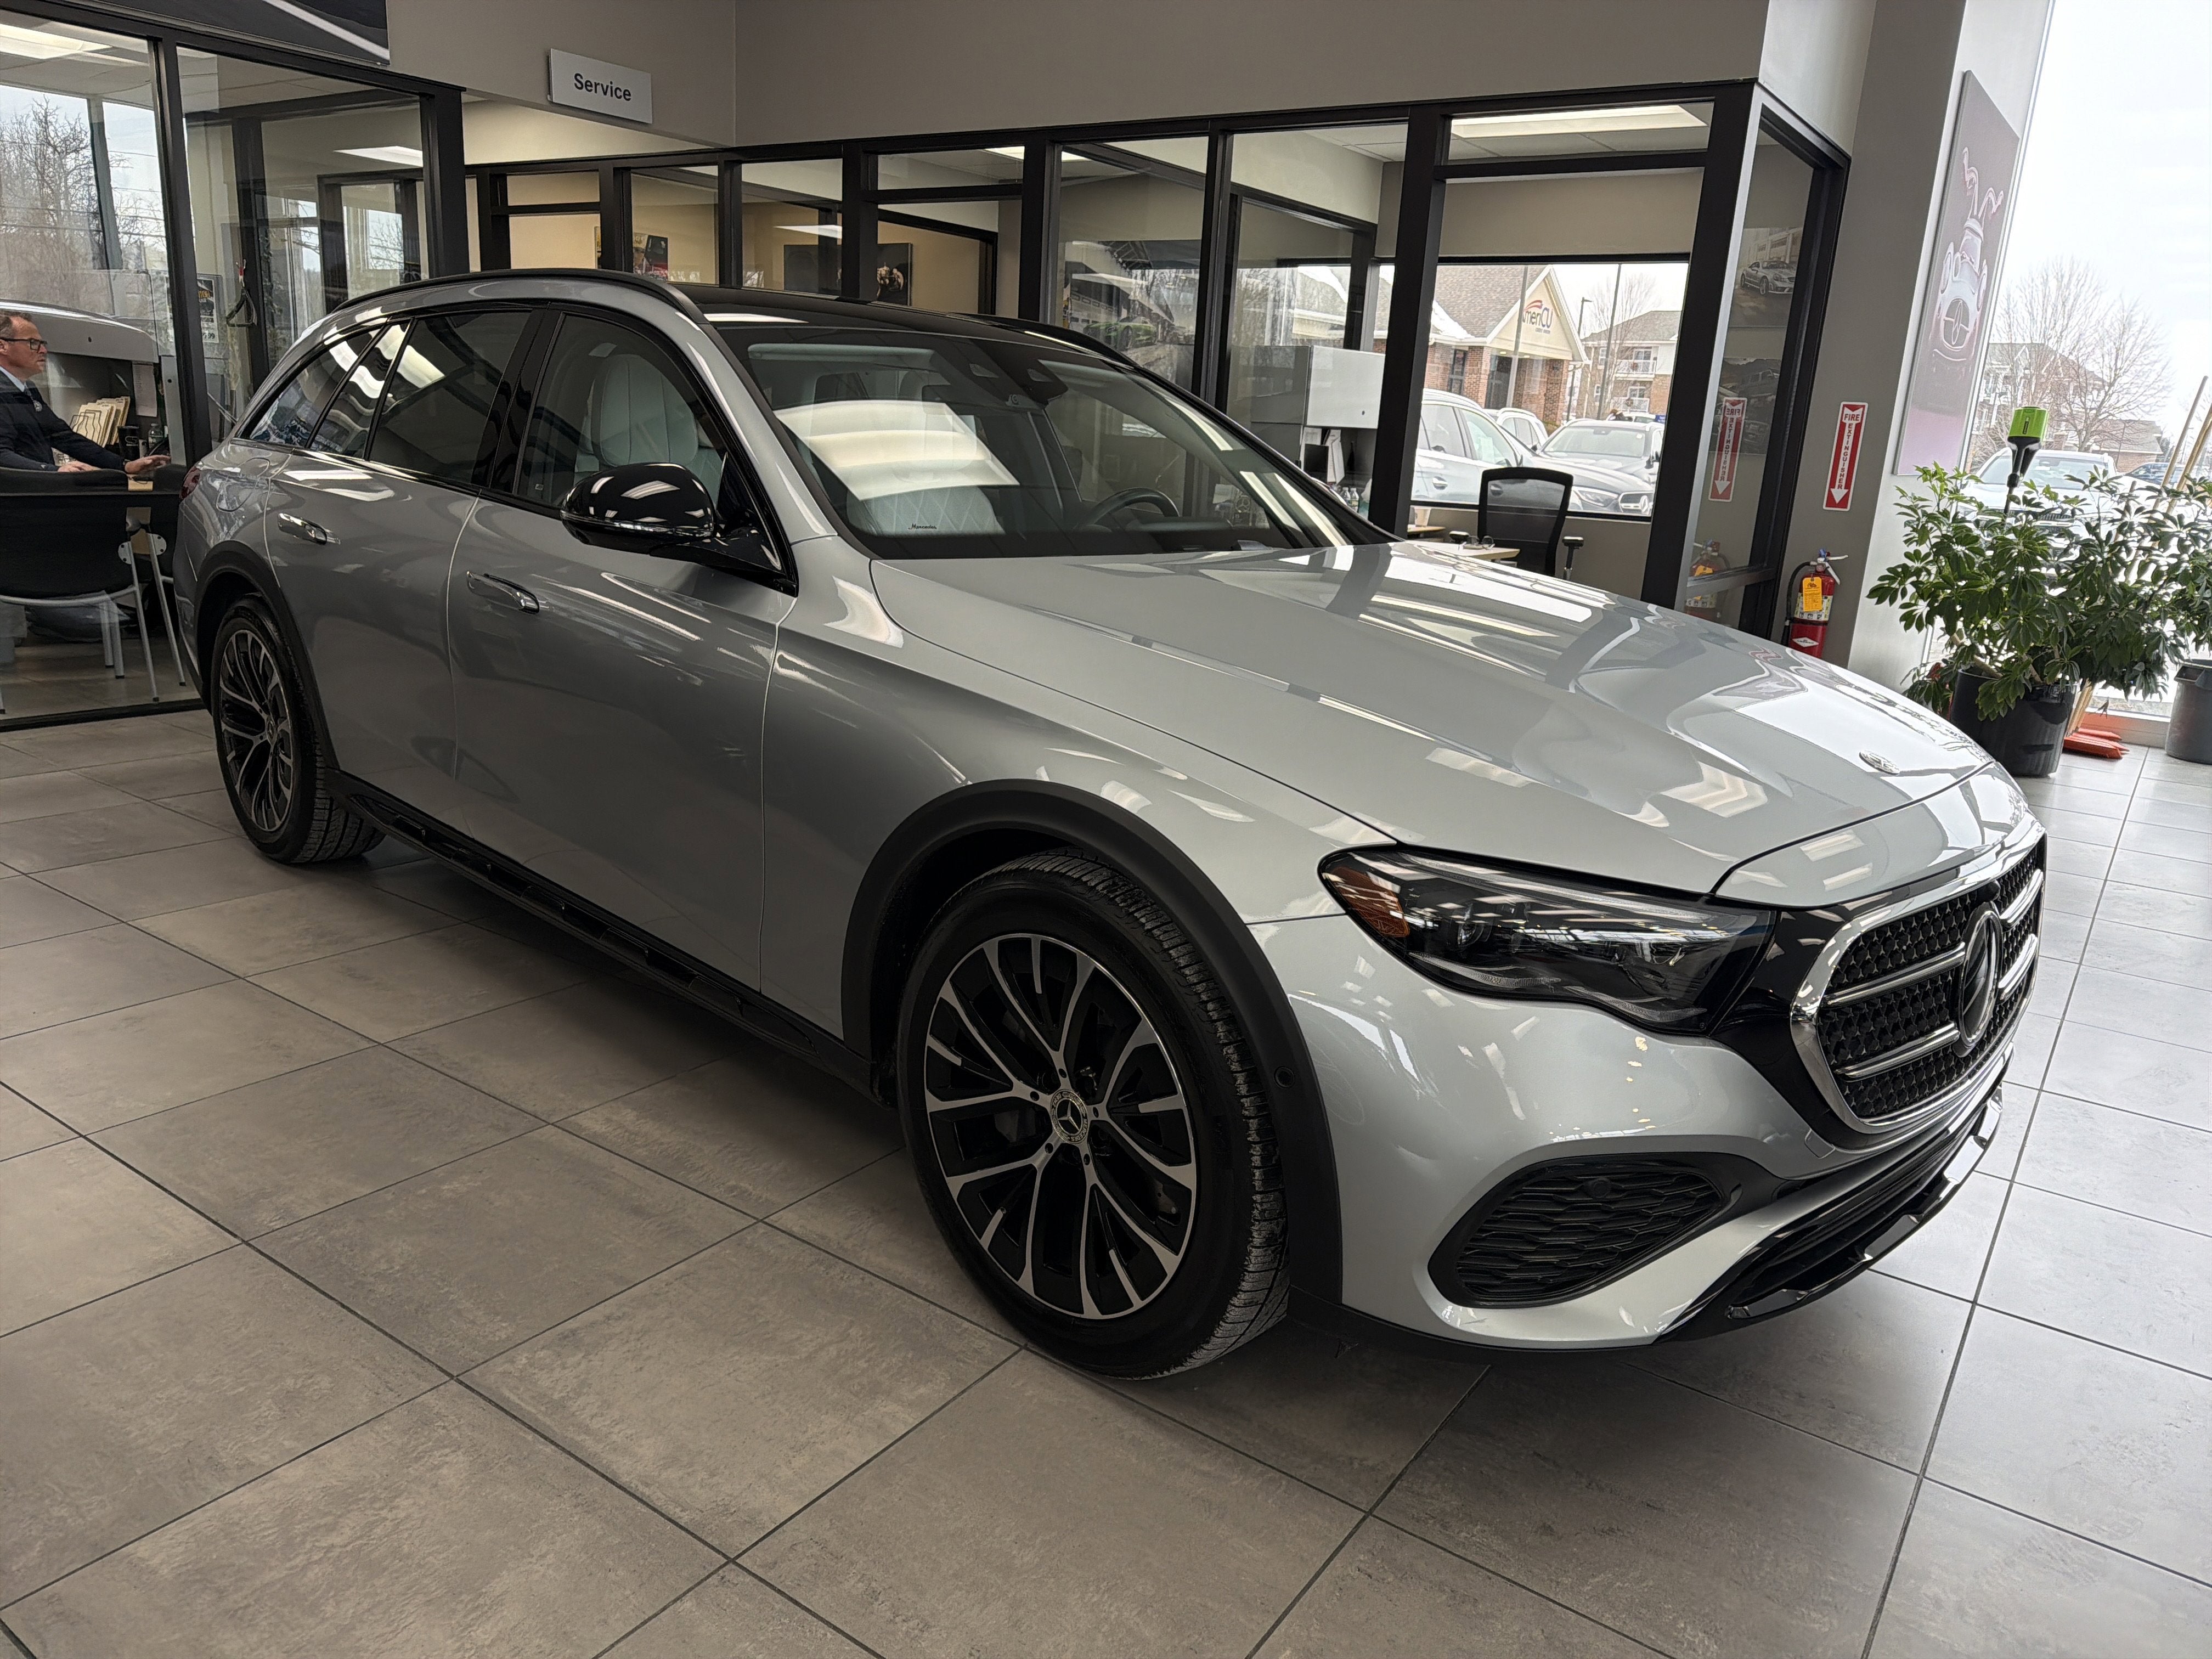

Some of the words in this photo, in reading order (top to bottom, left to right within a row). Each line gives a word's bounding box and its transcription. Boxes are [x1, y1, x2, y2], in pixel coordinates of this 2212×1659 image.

[574, 72, 632, 101] Service
[1844, 413, 1860, 421] FIRE
[1837, 423, 1854, 489] EXTINGUISHER
[1070, 1118, 1088, 1142] MERCEDES
